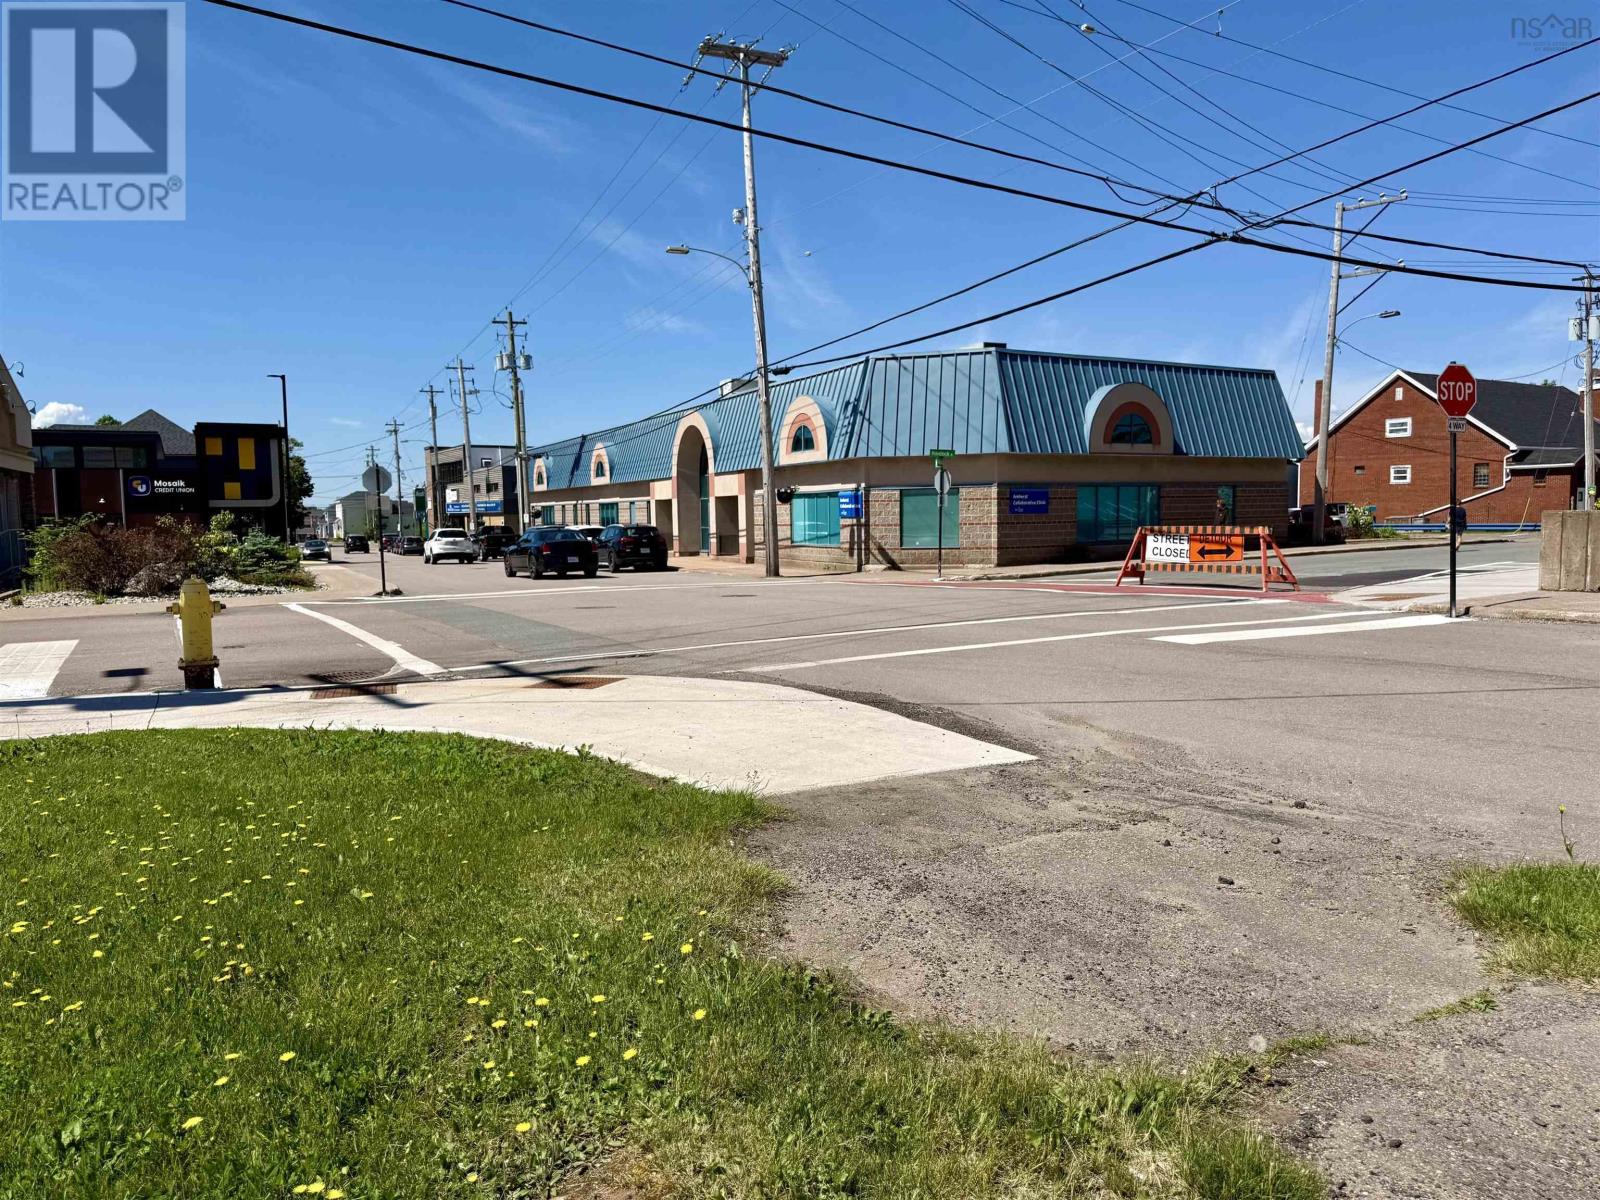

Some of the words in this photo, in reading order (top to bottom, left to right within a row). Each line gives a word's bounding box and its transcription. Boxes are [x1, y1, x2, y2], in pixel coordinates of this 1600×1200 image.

[1440, 381, 1474, 401] STOP
[1448, 422, 1453, 430] 4
[1453, 422, 1464, 430] WAY
